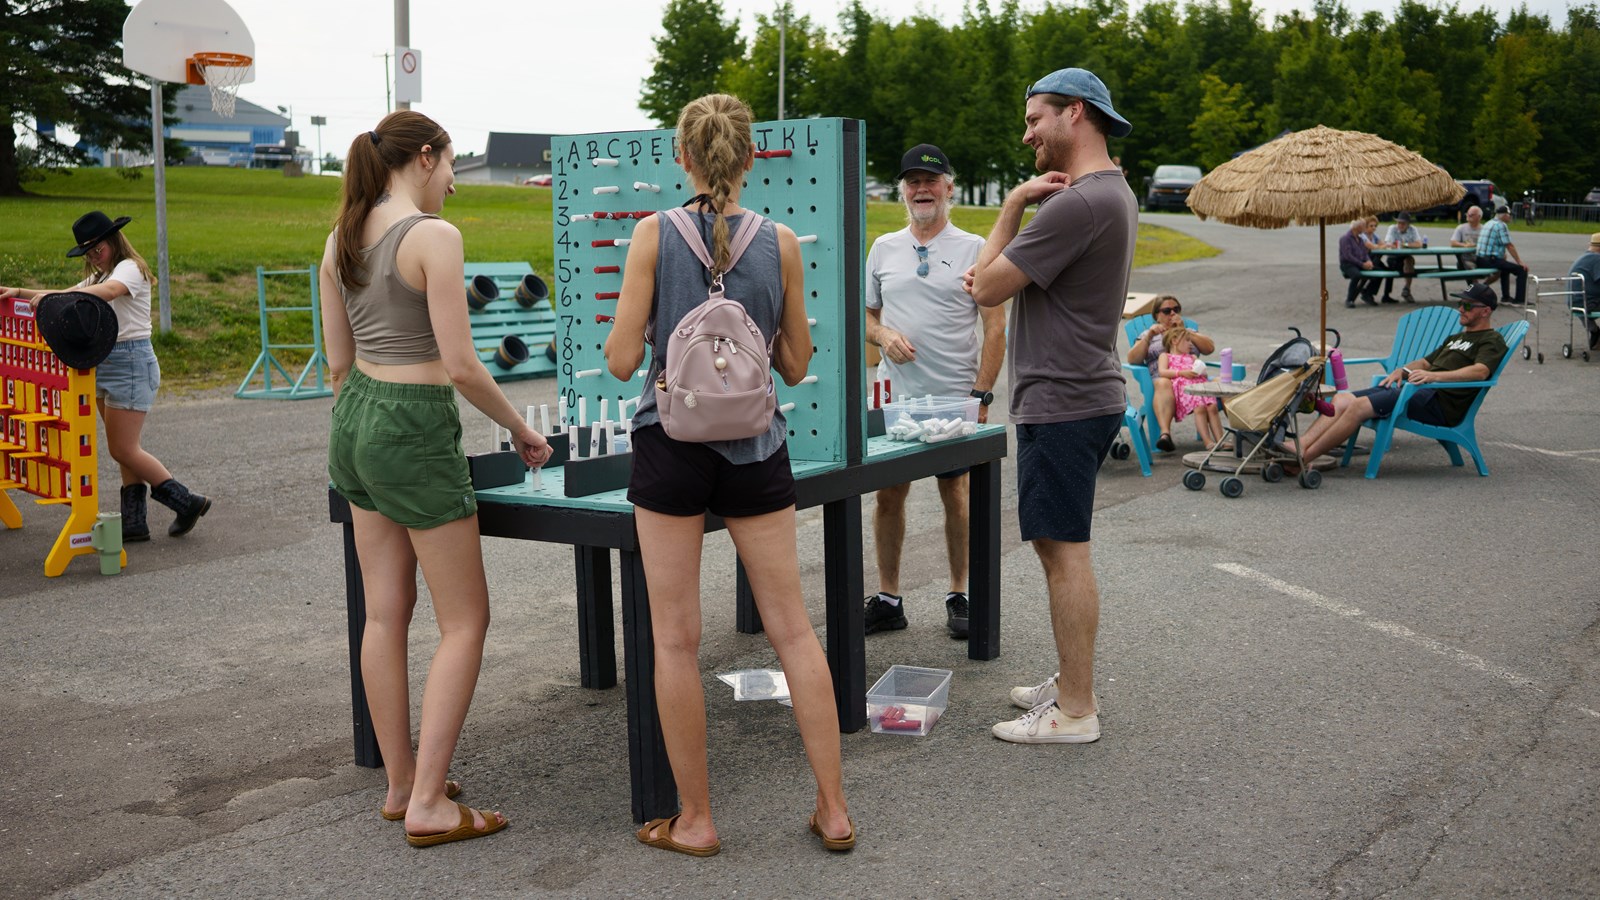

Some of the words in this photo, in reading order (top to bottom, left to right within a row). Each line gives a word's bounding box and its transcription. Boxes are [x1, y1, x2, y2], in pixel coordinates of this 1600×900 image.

[567, 141, 581, 163] A
[586, 140, 600, 160] B
[607, 138, 621, 158] C
[626, 140, 642, 158] D
[651, 137, 662, 156] E
[756, 128, 773, 151] J
[783, 127, 795, 149] K
[807, 124, 818, 147] L
[557, 156, 567, 176] 1
[558, 180, 568, 200] 2
[557, 206, 570, 227] 3
[557, 230, 571, 254] 4
[558, 259, 571, 283] 5
[561, 286, 572, 307] 6
[560, 315, 573, 336] 7
[562, 337, 573, 360] 8
[562, 362, 573, 385] 9
